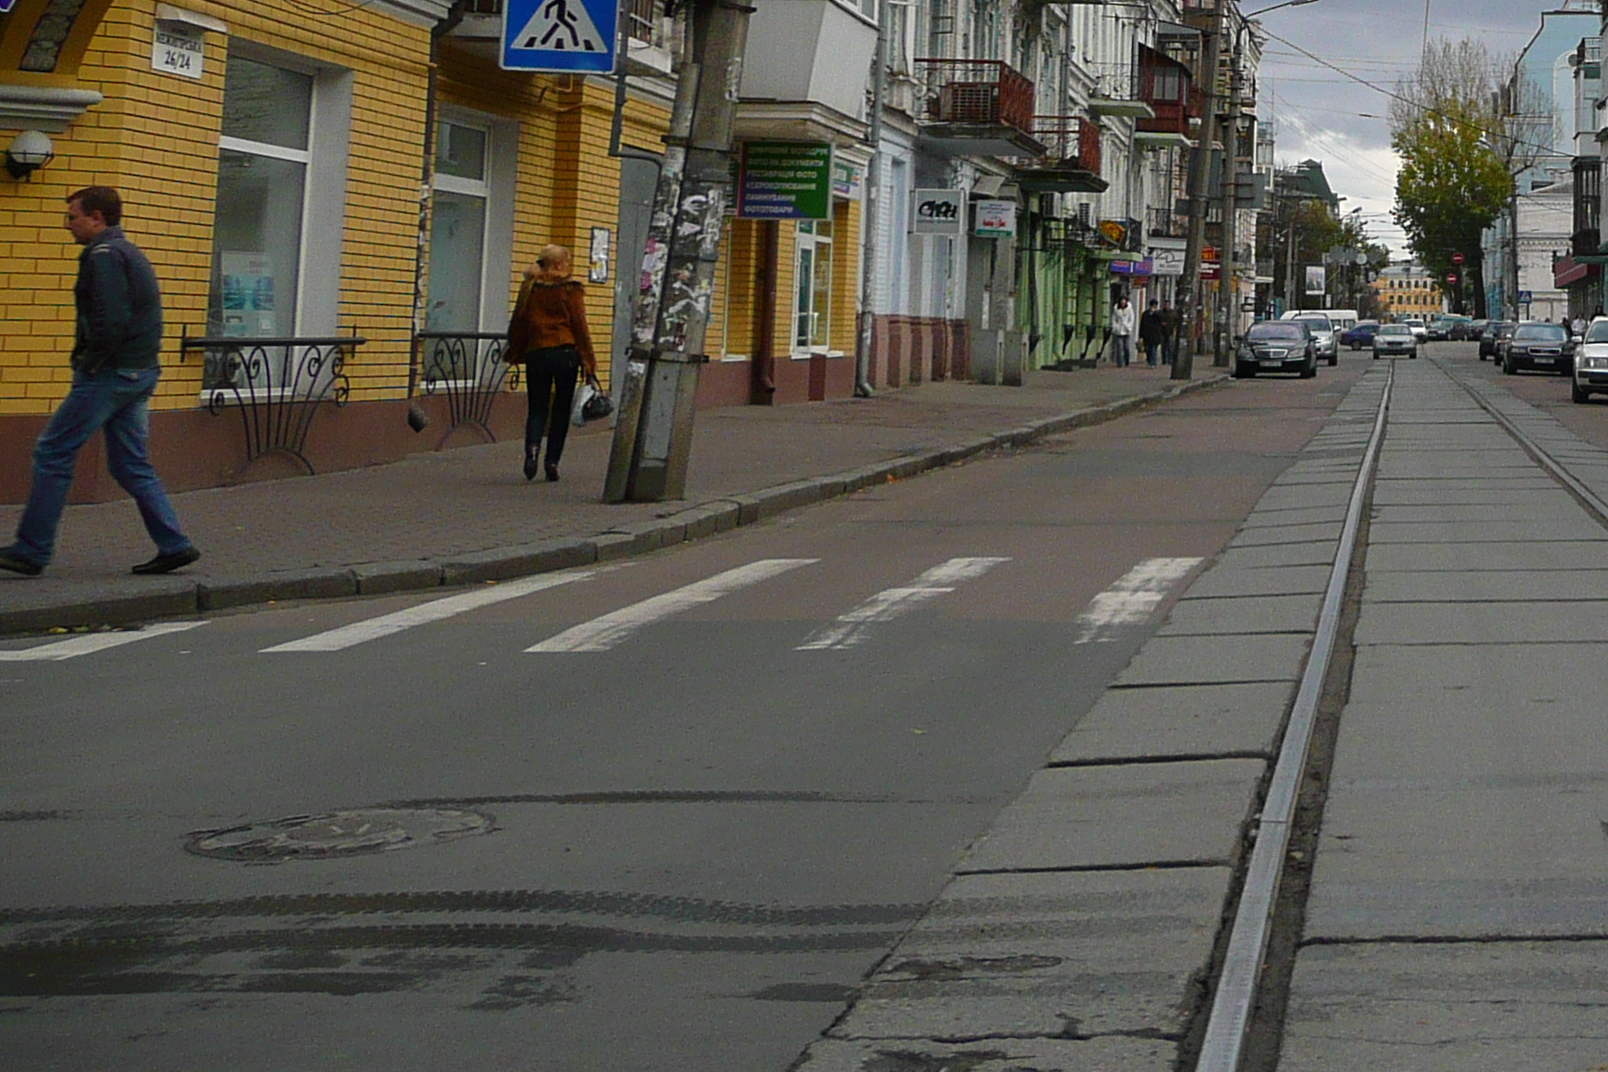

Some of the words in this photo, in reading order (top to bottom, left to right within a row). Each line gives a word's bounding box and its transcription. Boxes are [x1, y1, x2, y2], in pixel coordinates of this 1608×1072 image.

[165, 49, 191, 70] 26/24
[796, 171, 818, 179] ФОТО
[744, 205, 794, 214] ФОТОТОВАРИ
